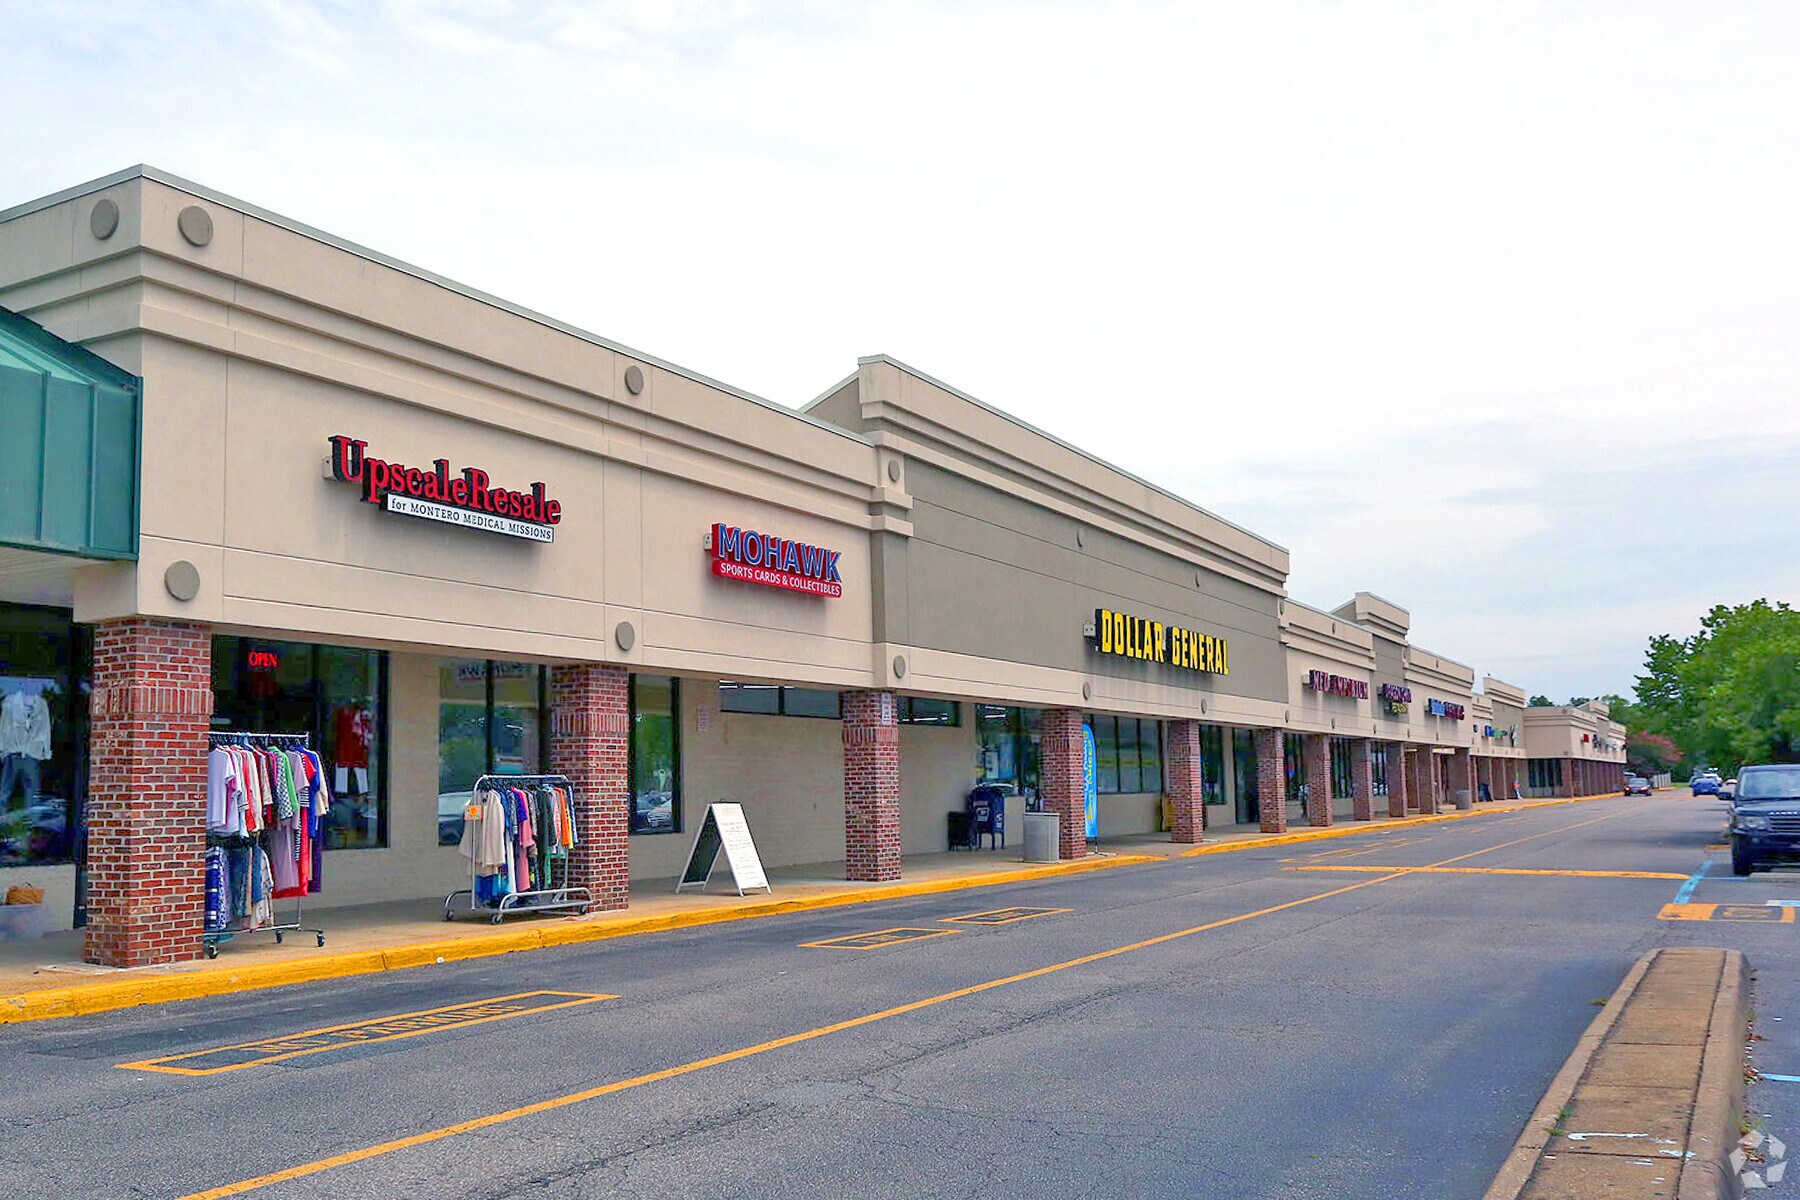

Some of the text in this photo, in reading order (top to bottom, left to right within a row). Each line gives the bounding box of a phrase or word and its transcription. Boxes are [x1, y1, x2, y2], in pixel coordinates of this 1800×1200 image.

[391, 497, 552, 540] for MONTERO MEDICAL MISSIONS
[718, 523, 841, 583] MOHAWK
[720, 563, 840, 596] SPORTS CARDS & COLLECTIBLES
[249, 651, 277, 668] OPEN
[1101, 609, 1229, 675] DOLLAR GENERAL
